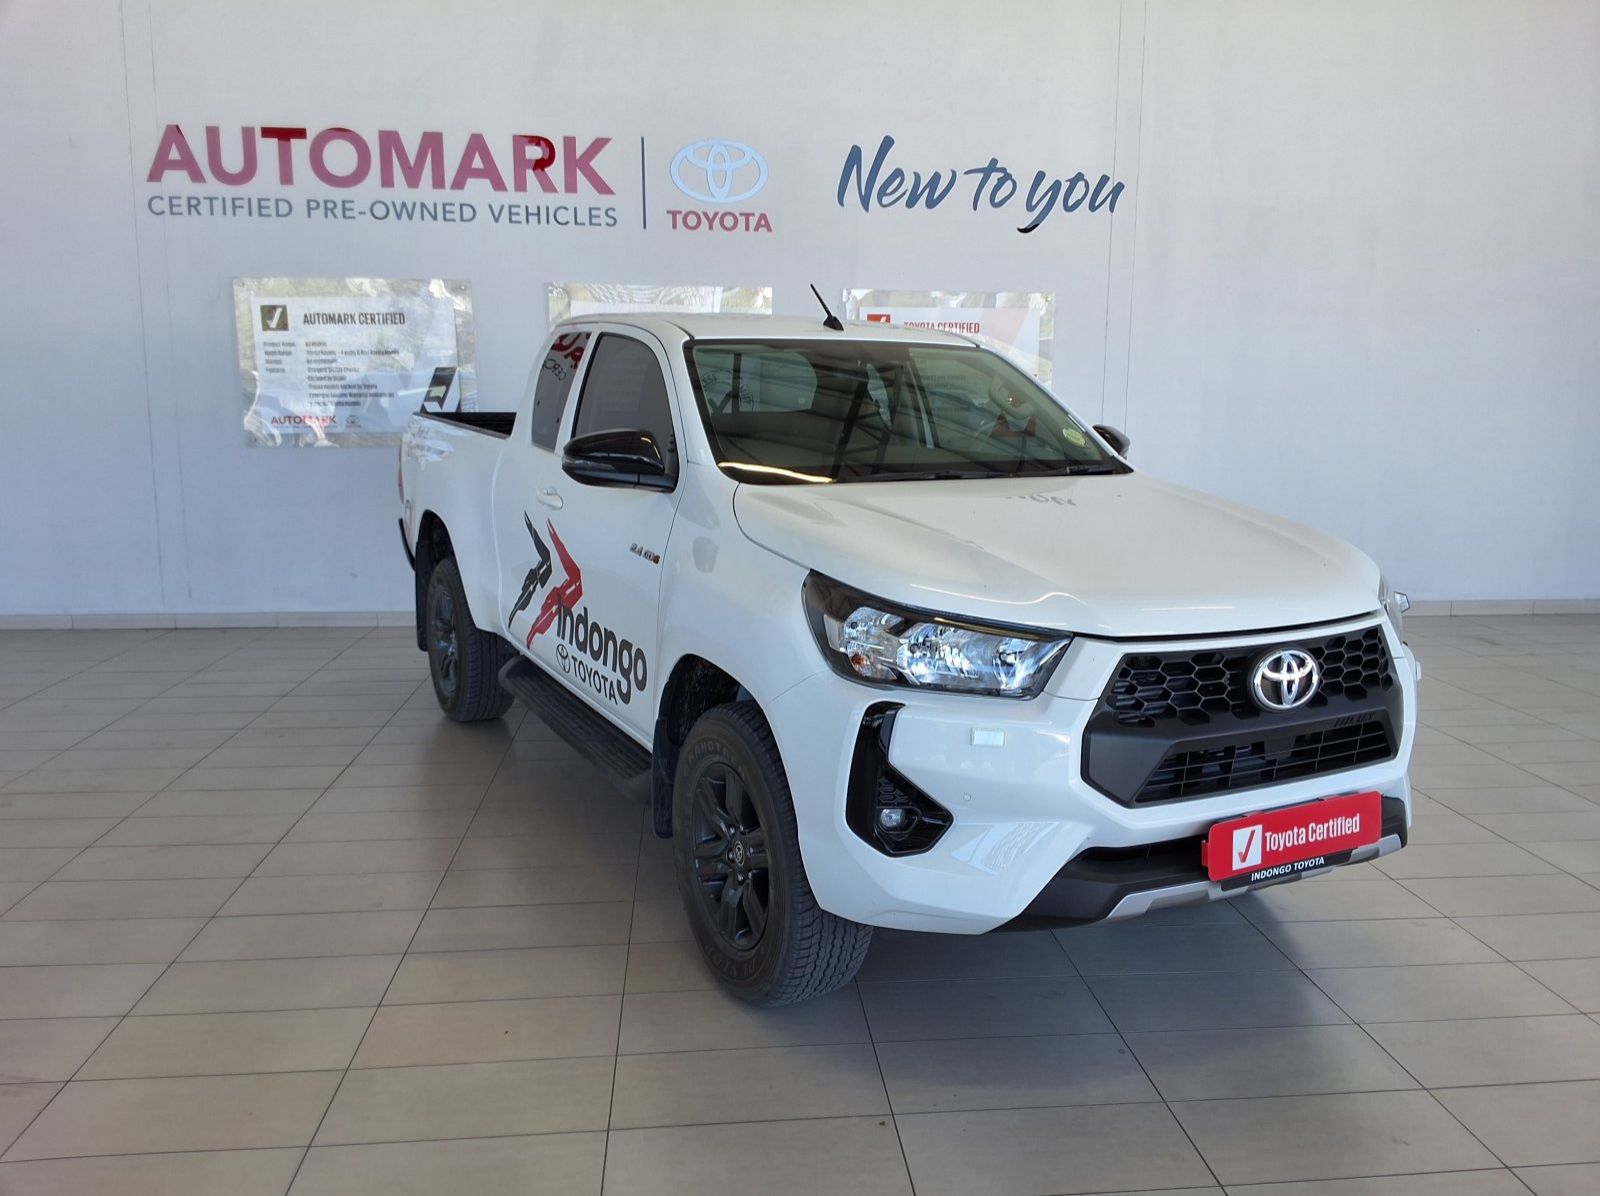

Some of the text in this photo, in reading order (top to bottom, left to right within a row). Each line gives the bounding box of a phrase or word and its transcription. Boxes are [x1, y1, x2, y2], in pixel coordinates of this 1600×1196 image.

[146, 123, 616, 195] AUTOMARK
[837, 135, 1126, 234] New to you
[147, 195, 619, 228] CERTIFIED PRE-OWNED VEHICLES
[666, 209, 773, 233] TOYOTA
[303, 312, 406, 326] AUTOMARK CERTIFIED
[571, 655, 618, 706] TOYOTA
[1264, 813, 1361, 852] Toyota Certified
[1251, 856, 1326, 882] INDONGO TOYOTA
